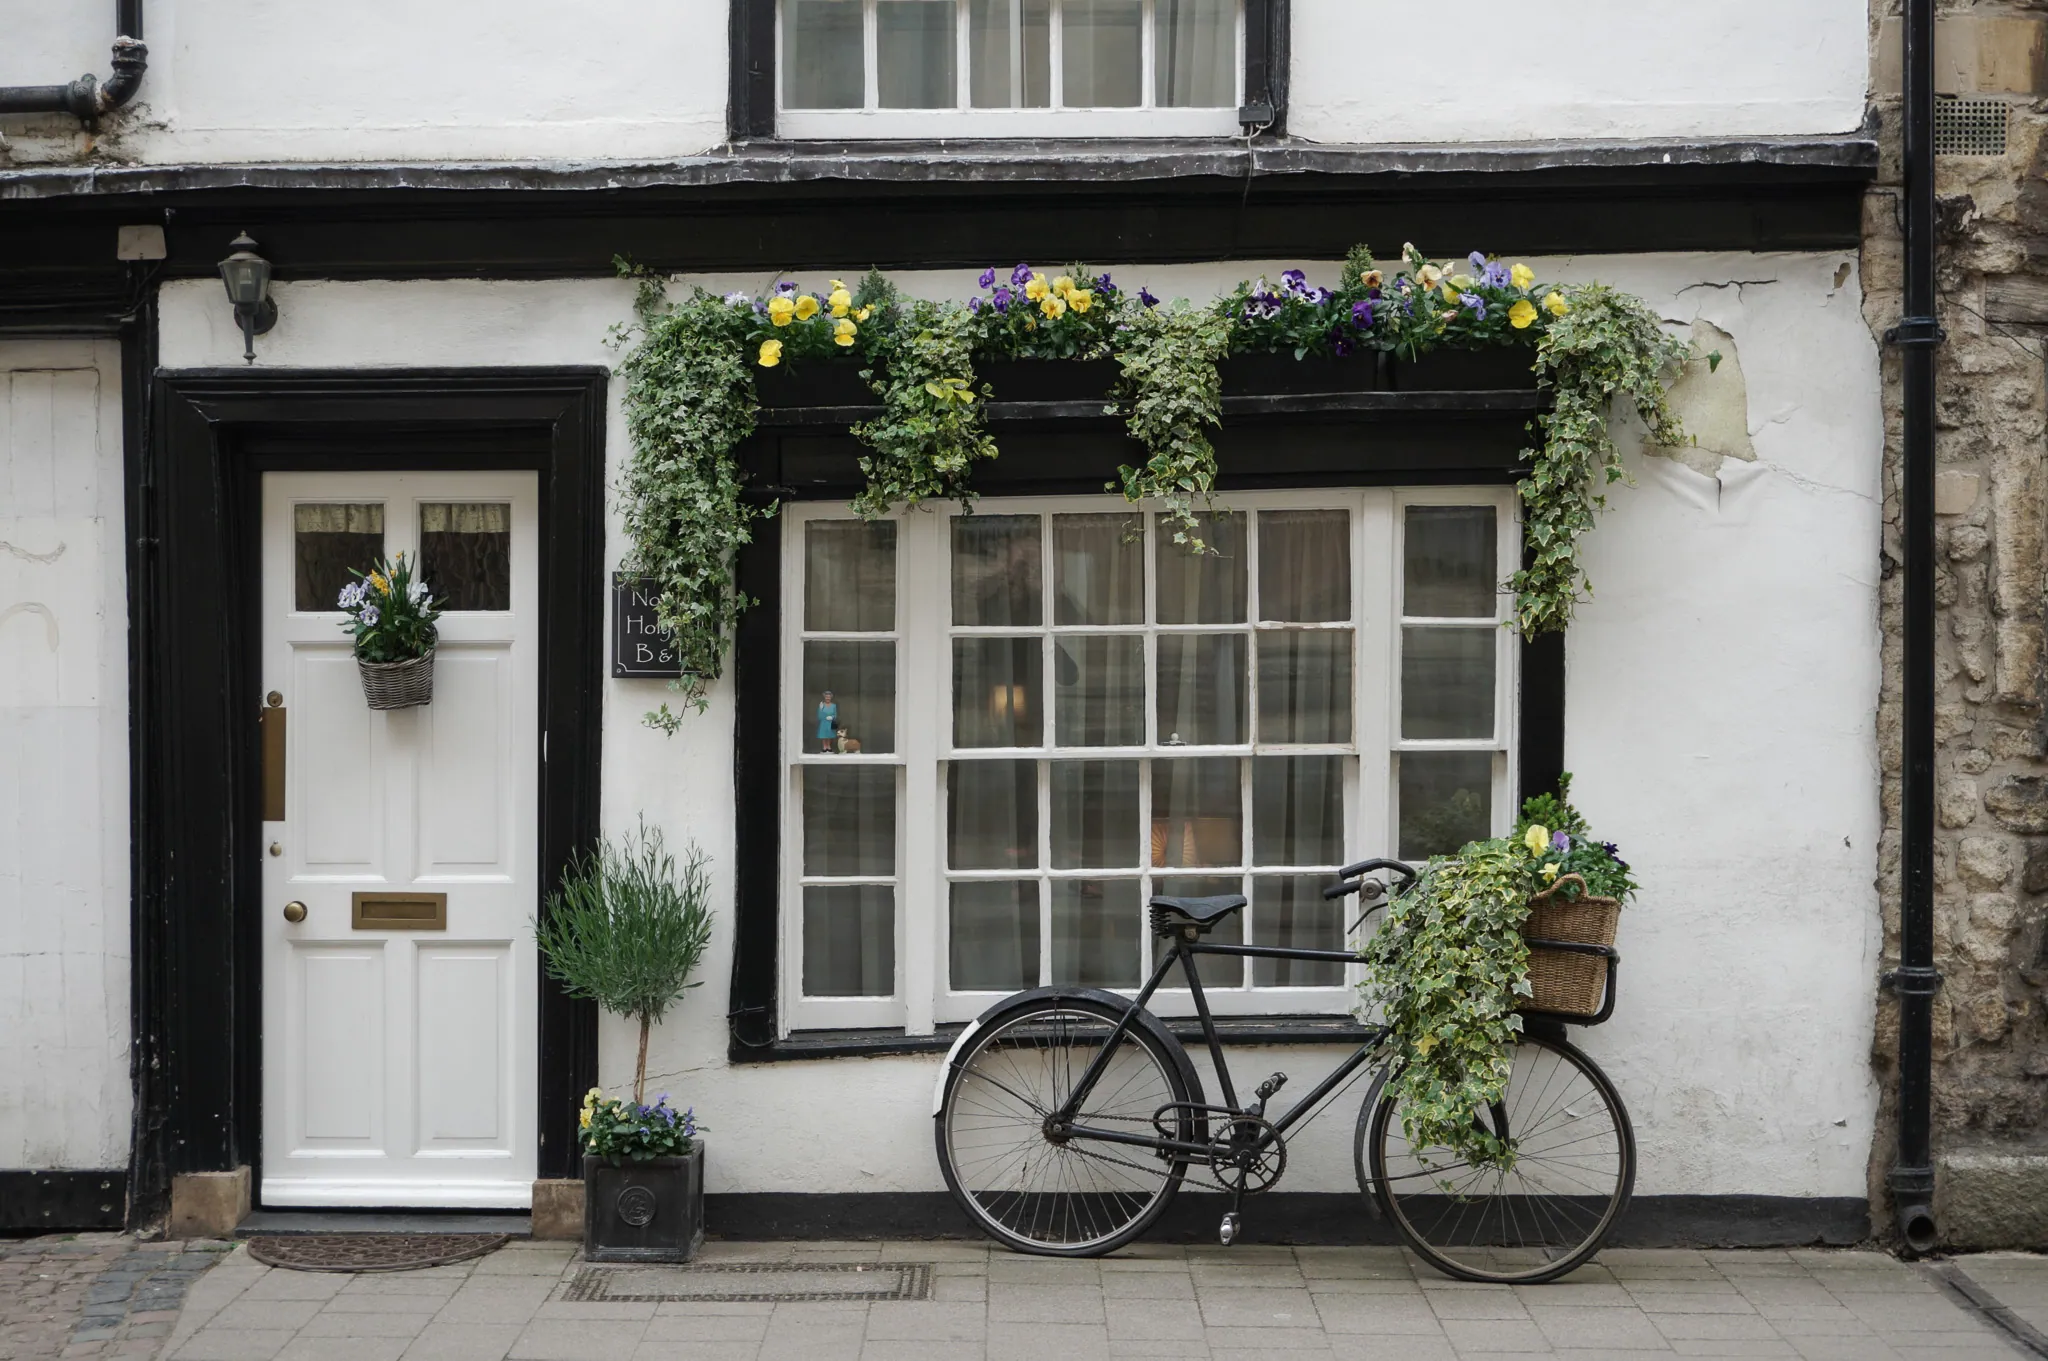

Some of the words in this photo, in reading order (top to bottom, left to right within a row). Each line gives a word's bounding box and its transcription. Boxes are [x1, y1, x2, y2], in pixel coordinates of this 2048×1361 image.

[627, 615, 705, 642] Holy
[636, 643, 654, 663] B
[659, 648, 673, 663] &
